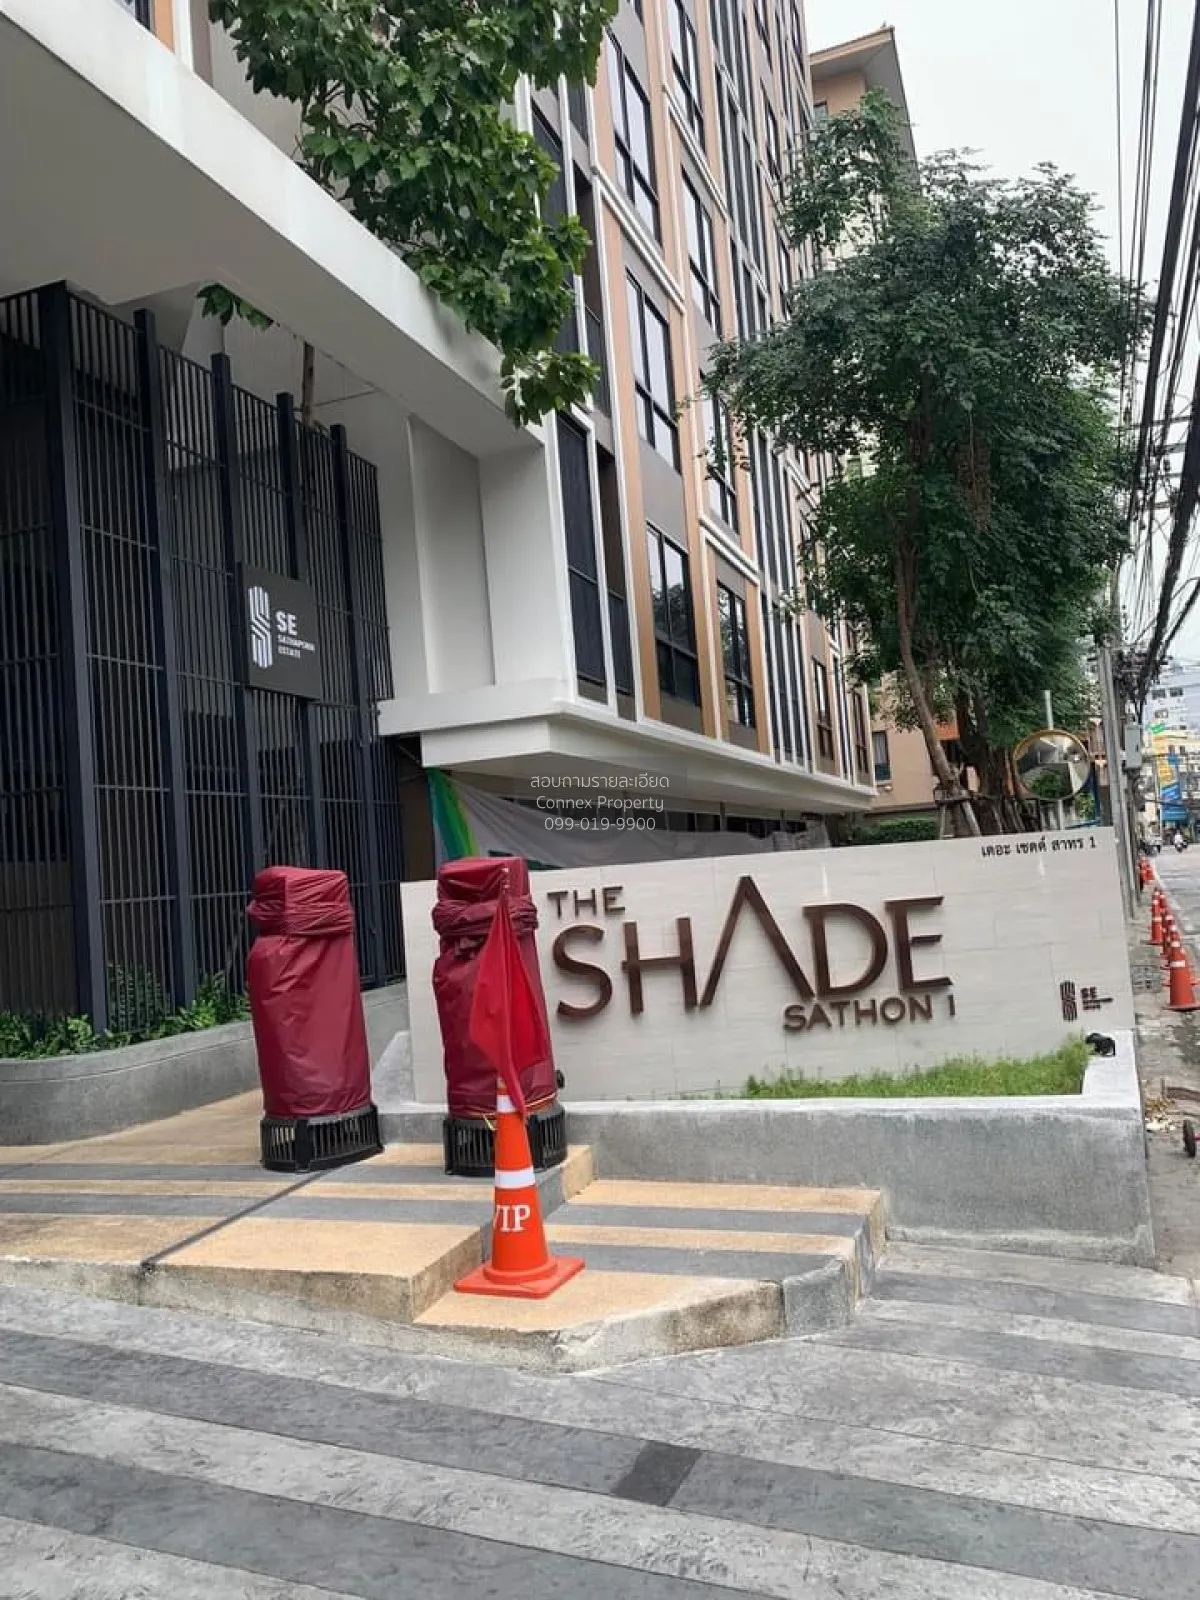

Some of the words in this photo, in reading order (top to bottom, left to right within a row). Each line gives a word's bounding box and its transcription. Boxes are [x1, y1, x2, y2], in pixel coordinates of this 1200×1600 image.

[276, 610, 297, 635] SE
[547, 885, 626, 918] THE
[551, 874, 954, 1020] SHADE
[783, 994, 933, 1032] SATHON
